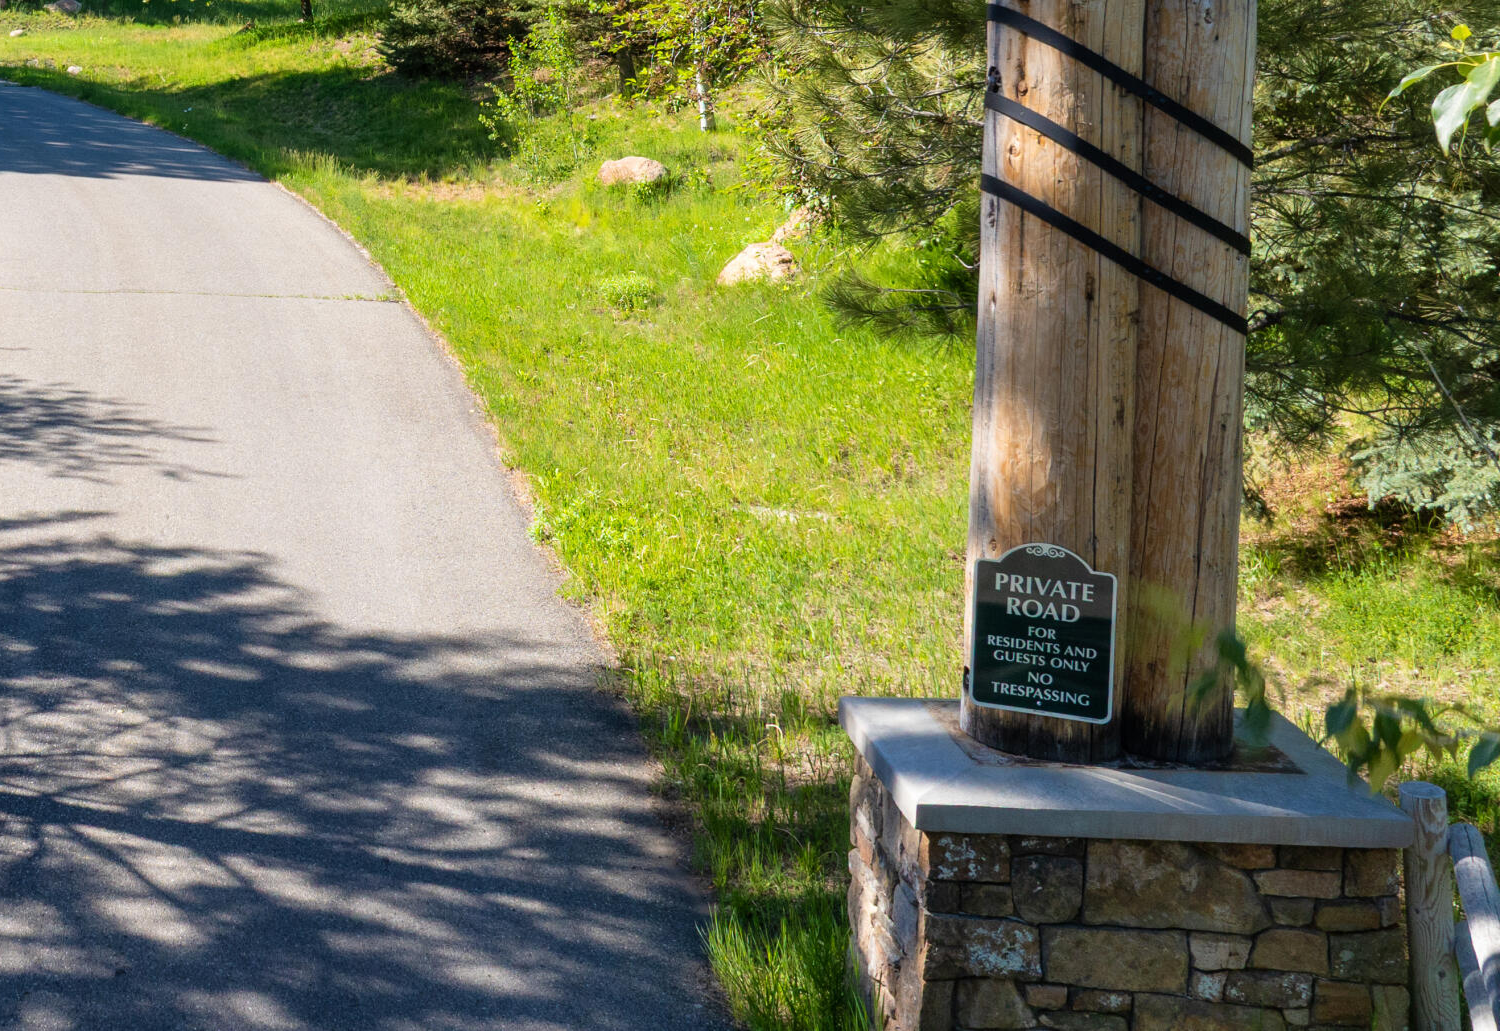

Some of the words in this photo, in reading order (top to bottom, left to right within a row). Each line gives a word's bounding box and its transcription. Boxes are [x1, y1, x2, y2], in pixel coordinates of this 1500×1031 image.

[995, 572, 1094, 602] PRIVATE
[1006, 597, 1080, 623] ROAD
[1028, 626, 1056, 639] FOR
[987, 634, 1060, 654] RESIDENTS
[1064, 646, 1097, 659] AND
[993, 650, 1046, 666] GUESTS
[1050, 658, 1090, 672] ONLY
[1027, 671, 1053, 685] NO
[991, 681, 1090, 706] TRESPASSING
